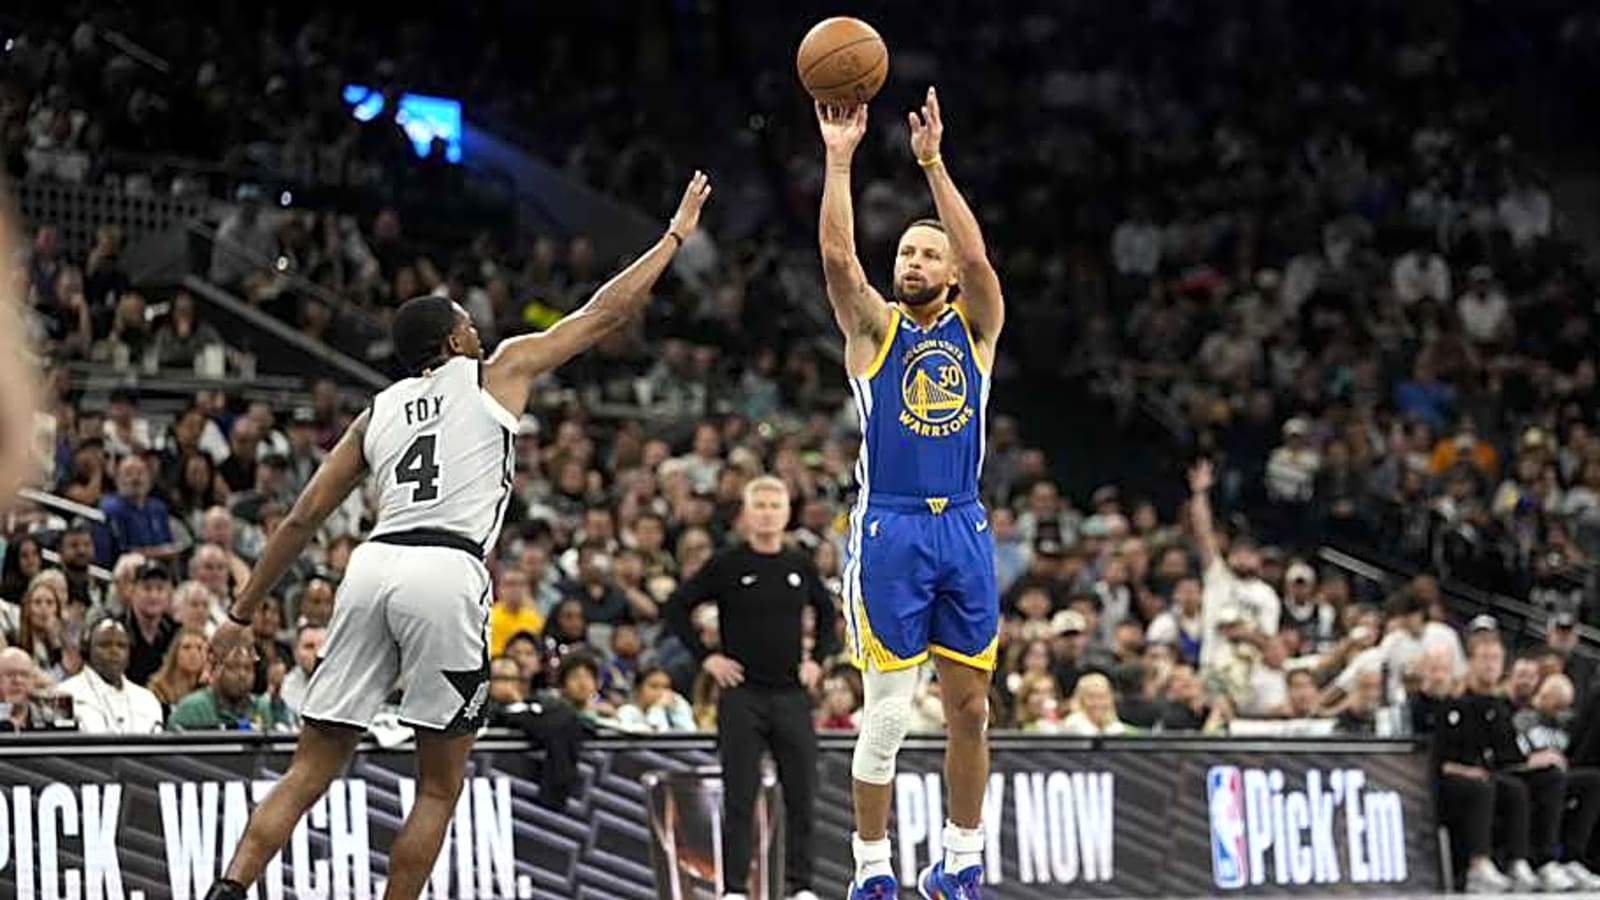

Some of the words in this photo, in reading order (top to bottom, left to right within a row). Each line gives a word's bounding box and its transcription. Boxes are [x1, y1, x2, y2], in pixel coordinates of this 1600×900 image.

[938, 365, 960, 388] 30
[405, 395, 444, 425] FOX
[899, 405, 974, 436] WARRIORS
[394, 433, 440, 503] 4
[1013, 770, 1114, 884] NOW
